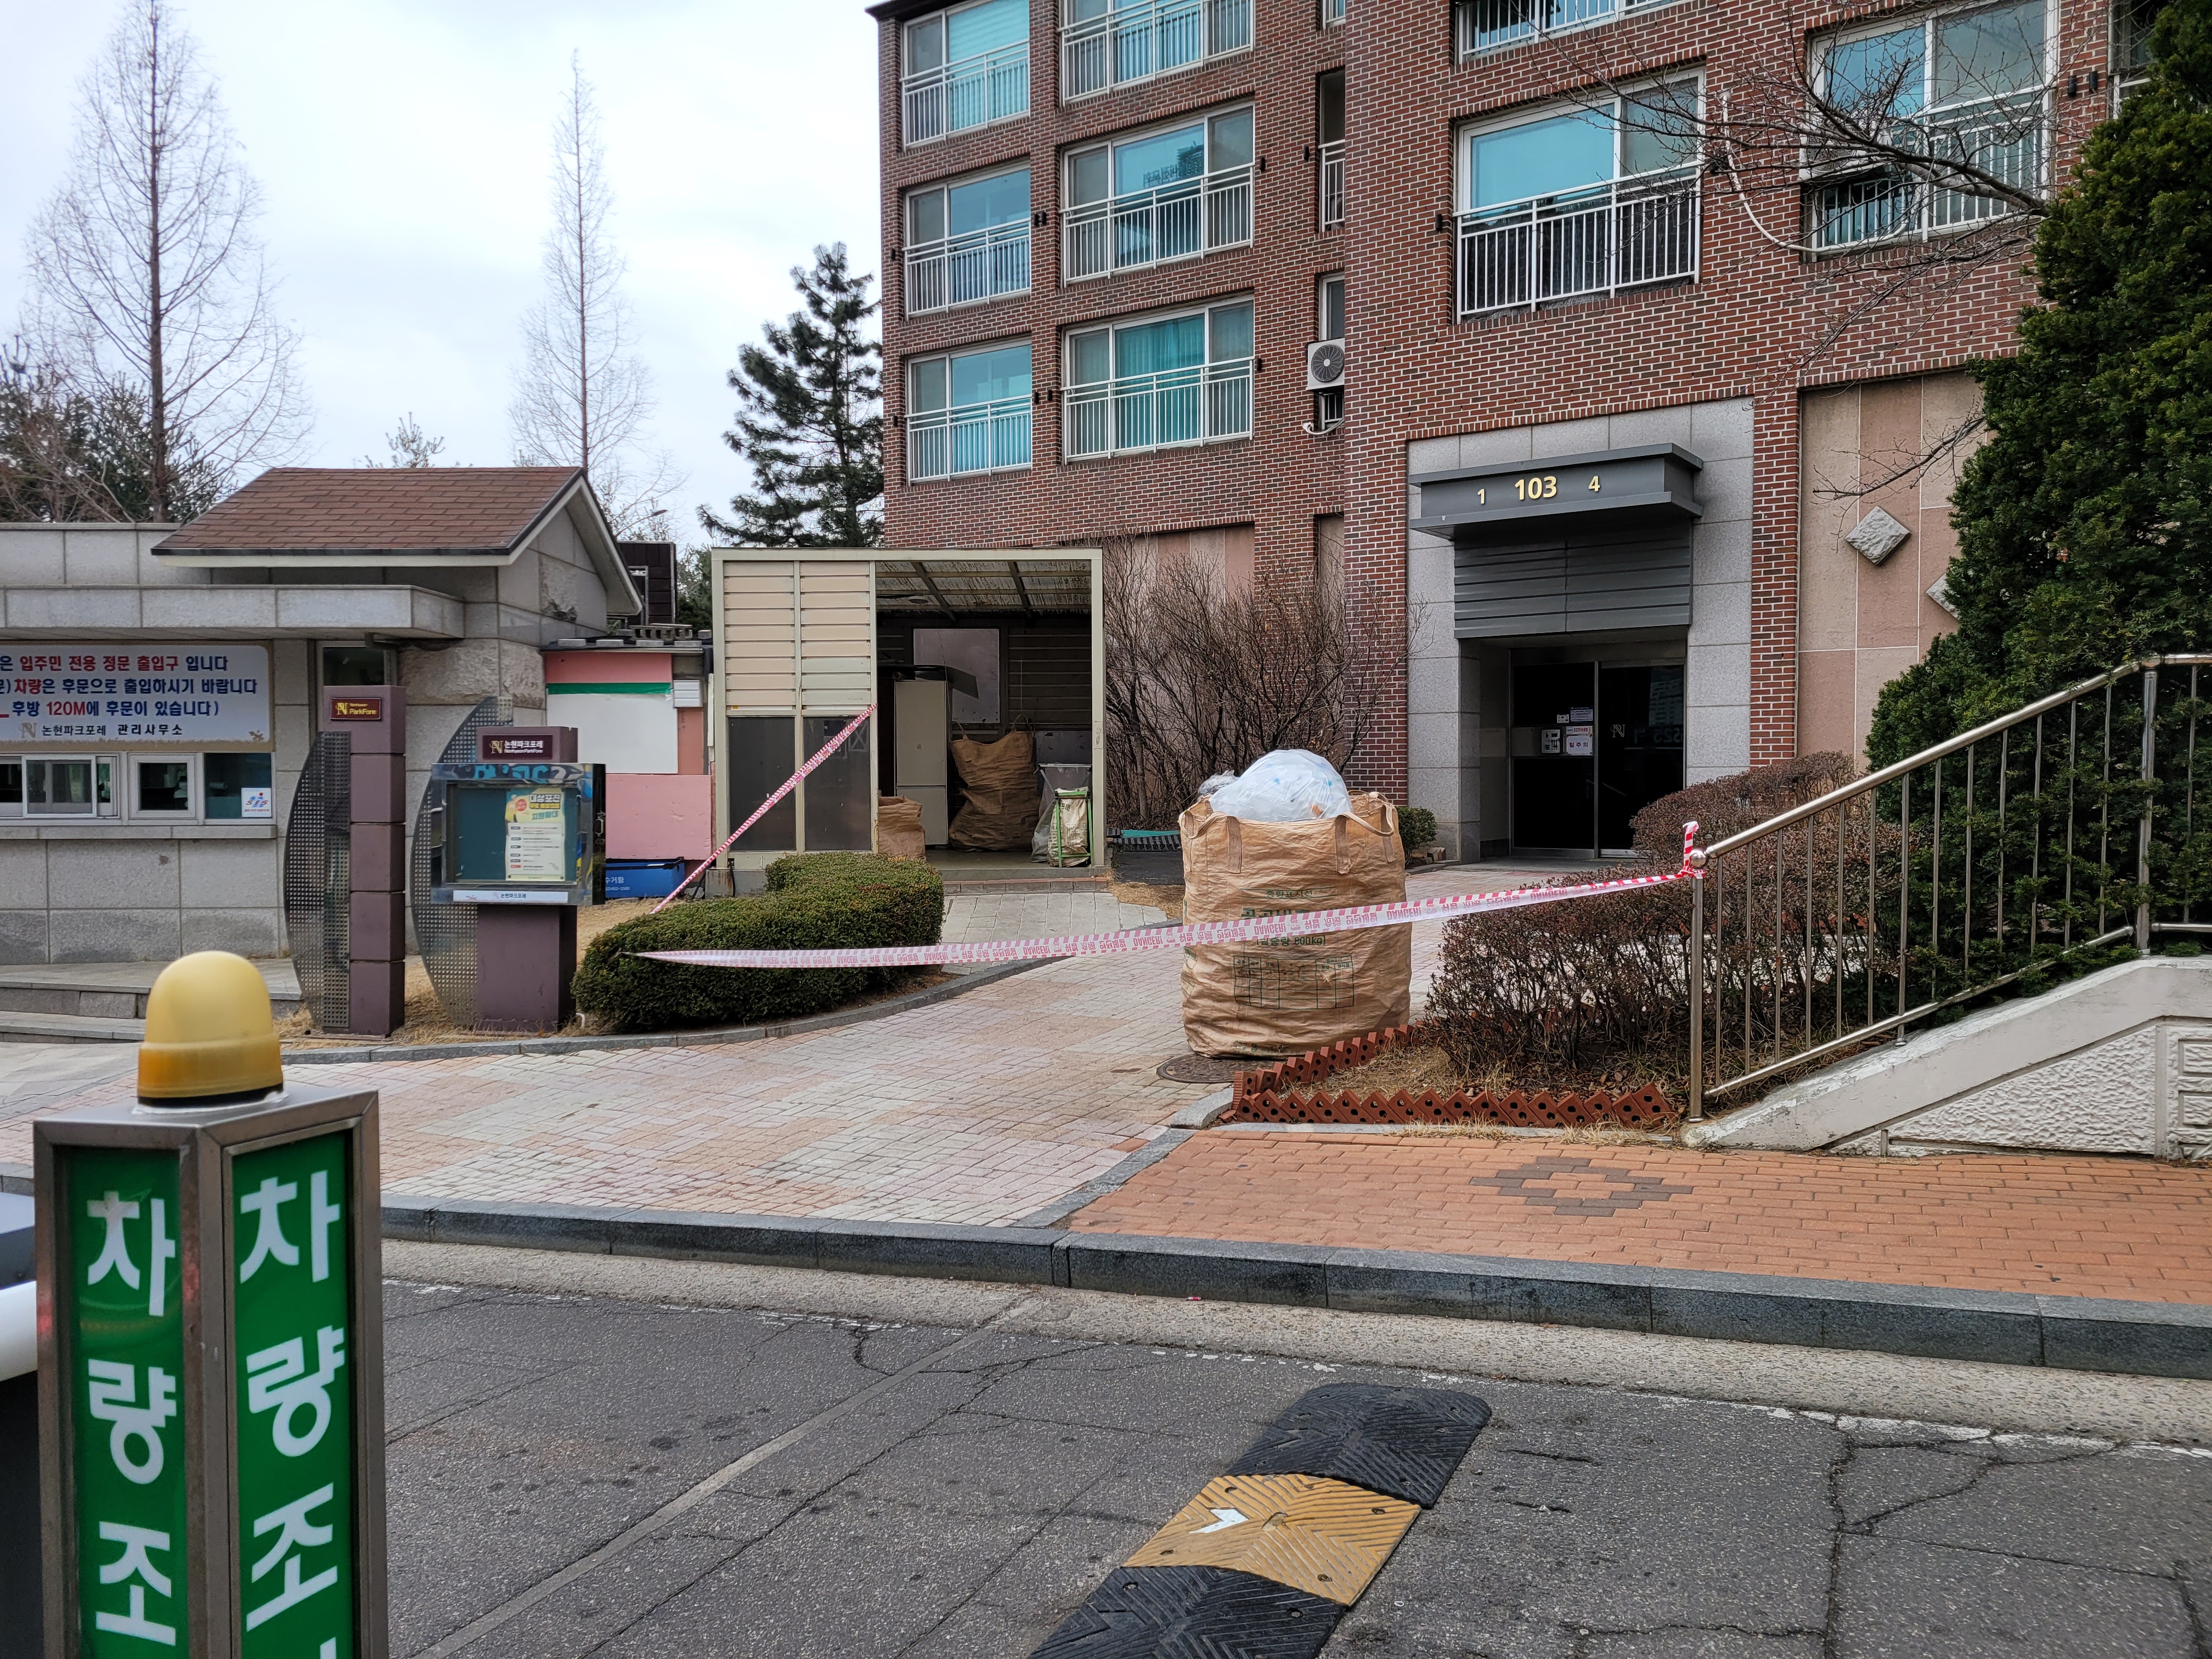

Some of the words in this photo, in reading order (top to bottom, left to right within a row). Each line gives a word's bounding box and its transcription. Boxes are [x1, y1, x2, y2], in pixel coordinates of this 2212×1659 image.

[1477, 488, 1486, 504] 1
[1514, 476, 1557, 501] 103
[1588, 476, 1600, 492] 4
[20, 656, 61, 671] 입주민
[69, 656, 95, 671] 전용
[103, 656, 129, 671] 정문
[137, 656, 178, 671] 출입구
[185, 656, 228, 671] 입니다
[63, 678, 117, 694] 후문으로
[125, 678, 194, 694] 출입하시기
[201, 679, 257, 694] 바랍니다
[12, 701, 40, 716] 후방
[46, 701, 99, 716] 120M에
[106, 701, 147, 716] 후문이
[42, 725, 106, 736] 논현파크포레
[117, 724, 183, 736] 관리사무소
[240, 1170, 345, 1659] 차량조
